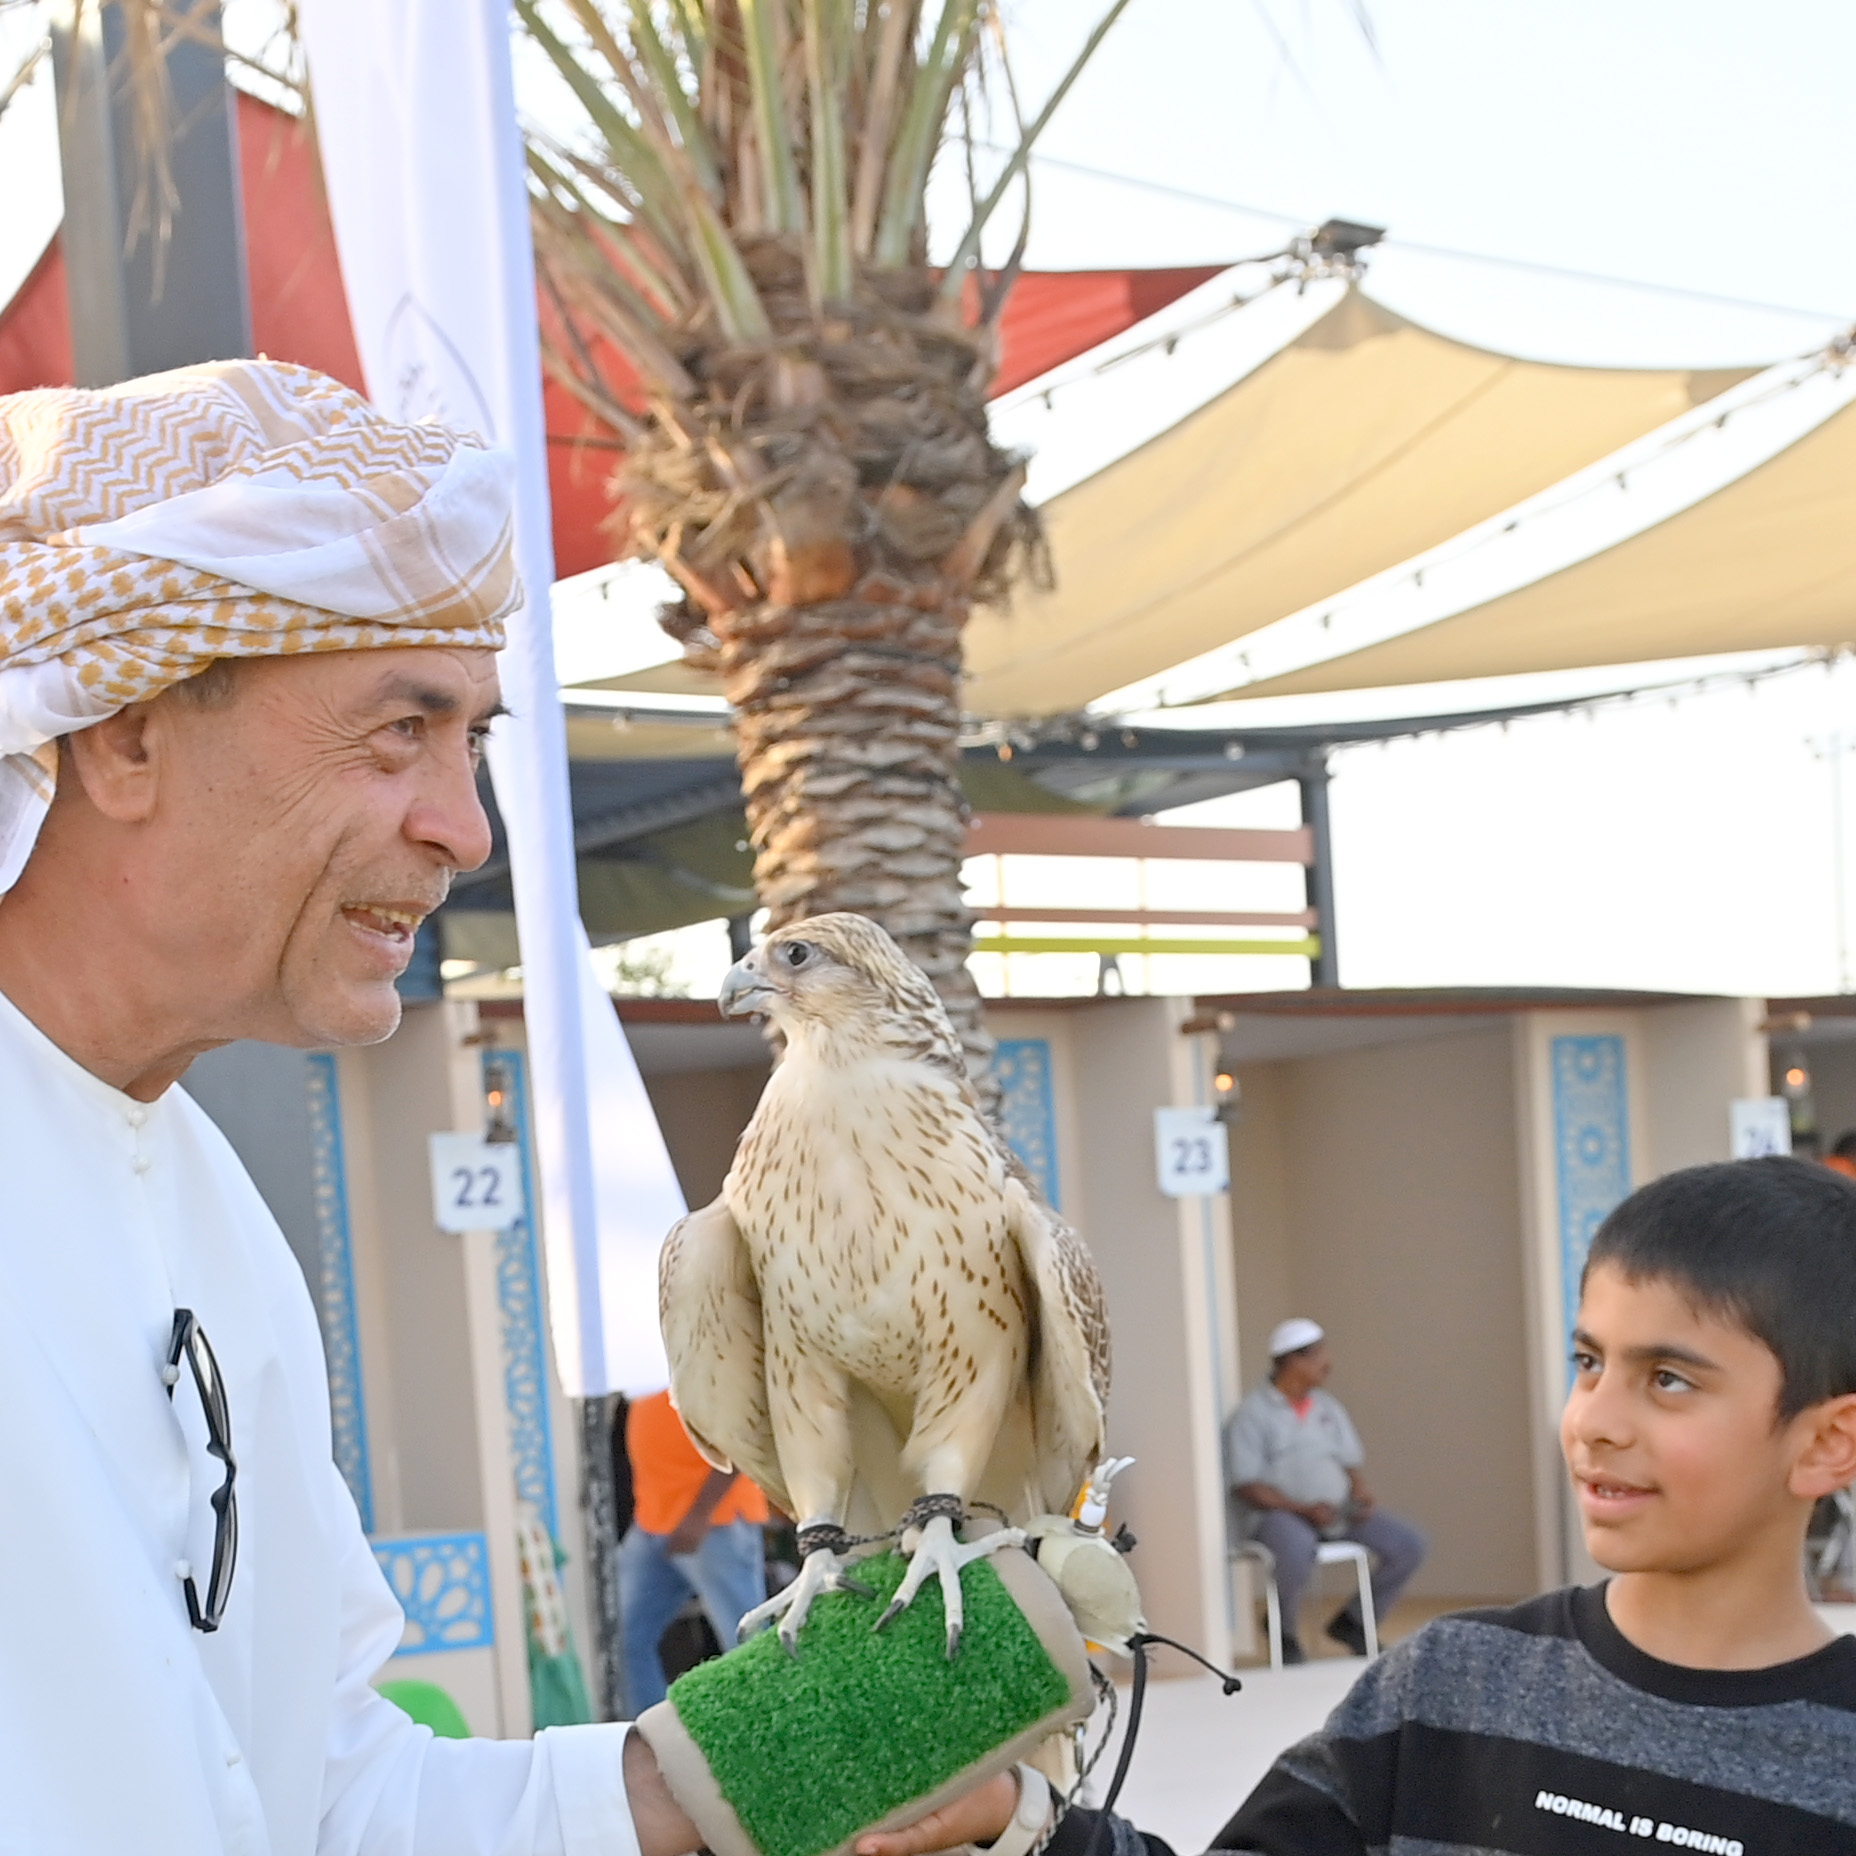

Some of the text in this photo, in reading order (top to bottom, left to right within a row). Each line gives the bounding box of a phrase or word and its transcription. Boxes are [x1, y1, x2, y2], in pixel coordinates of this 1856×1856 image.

[1172, 1137, 1213, 1173] 23
[452, 1166, 501, 1206] 22
[1535, 1790, 1626, 1832] NORMAL
[1629, 1815, 1655, 1838] IS
